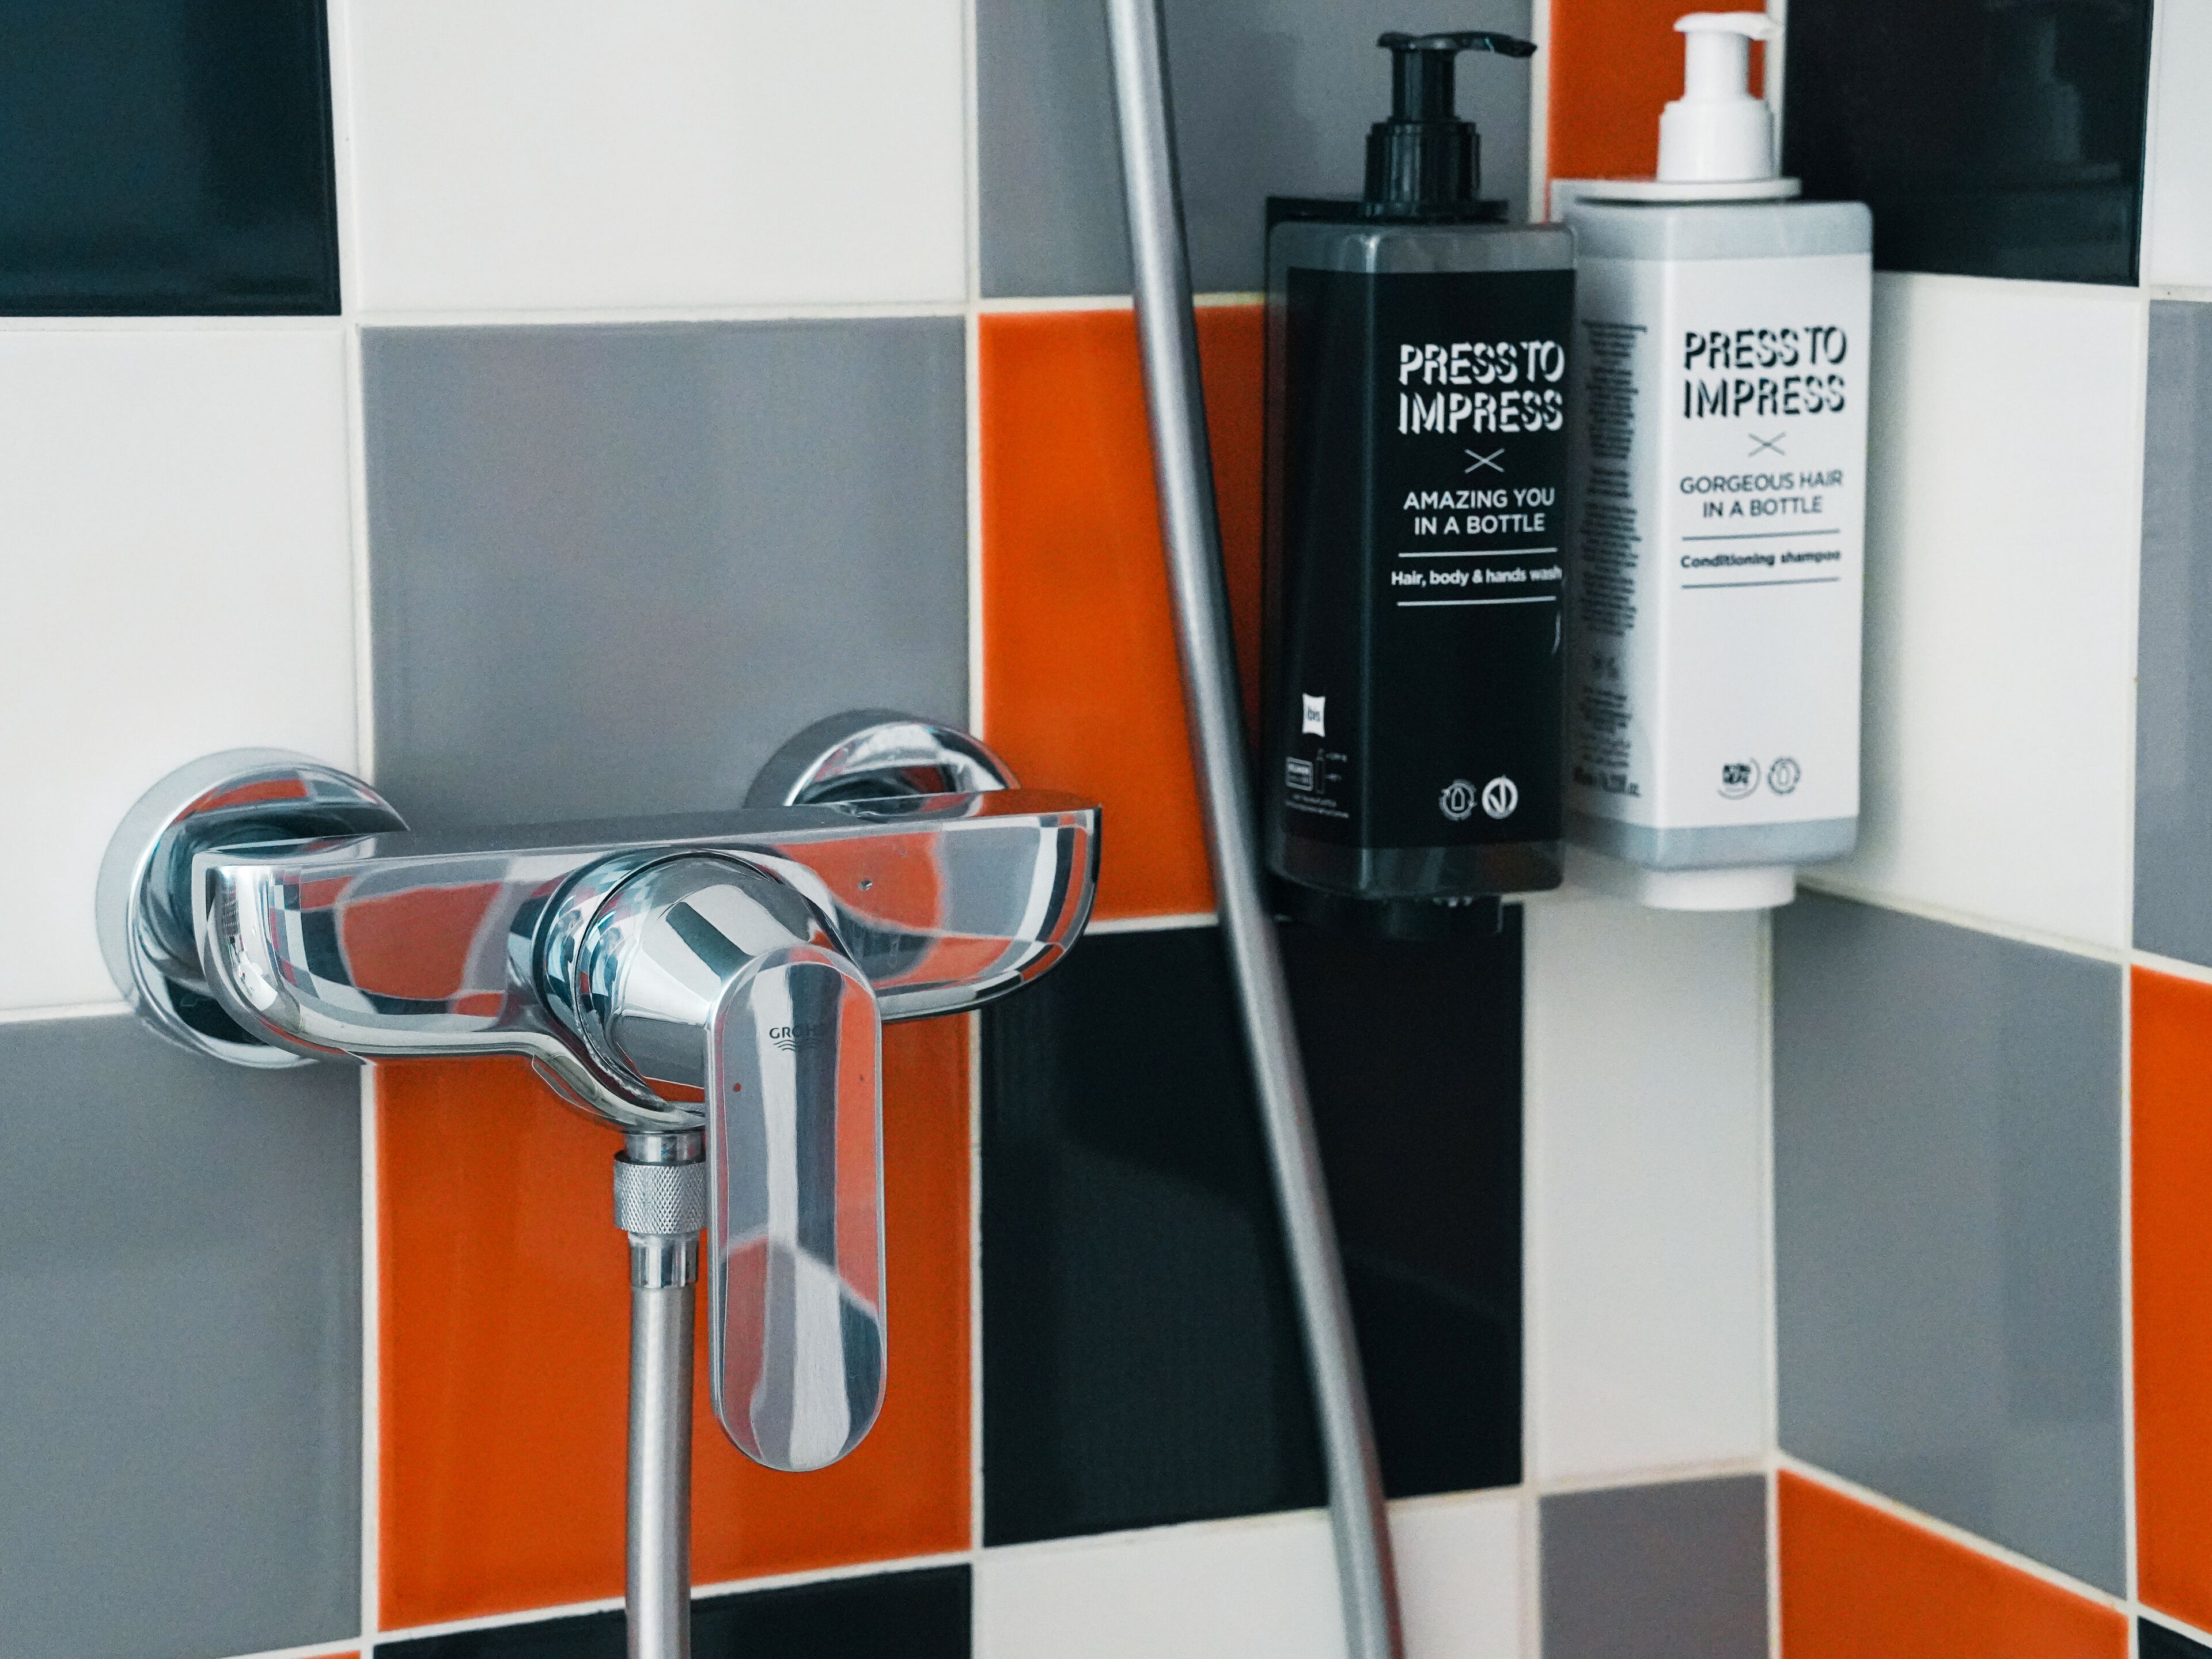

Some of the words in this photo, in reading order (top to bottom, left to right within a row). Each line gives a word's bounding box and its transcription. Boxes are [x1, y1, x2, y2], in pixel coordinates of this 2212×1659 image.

[1684, 328, 1799, 370] PRESS
[1804, 325, 1847, 366] TO
[1398, 341, 1518, 385] PRESS
[1520, 340, 1565, 383] TO
[1683, 374, 1845, 419] IMPRESS
[1398, 389, 1563, 435] IMPRESS
[1680, 472, 1794, 494] GORGEOUS
[1799, 469, 1843, 488] HAIR
[1403, 489, 1508, 510] AMAZING
[1513, 487, 1555, 507] YOU
[1703, 501, 1724, 518] IN
[1729, 499, 1744, 517] A
[1749, 495, 1823, 517] BOTTLE
[1414, 516, 1437, 536] IN
[1443, 516, 1460, 535] A
[1467, 513, 1546, 535] BOTTLE
[1680, 553, 1775, 569] Conditioning
[1781, 550, 1841, 564] shampoo
[1391, 570, 1426, 588] Hair,
[1429, 569, 1469, 587] body
[1472, 569, 1483, 584] &
[1485, 567, 1527, 583] hands
